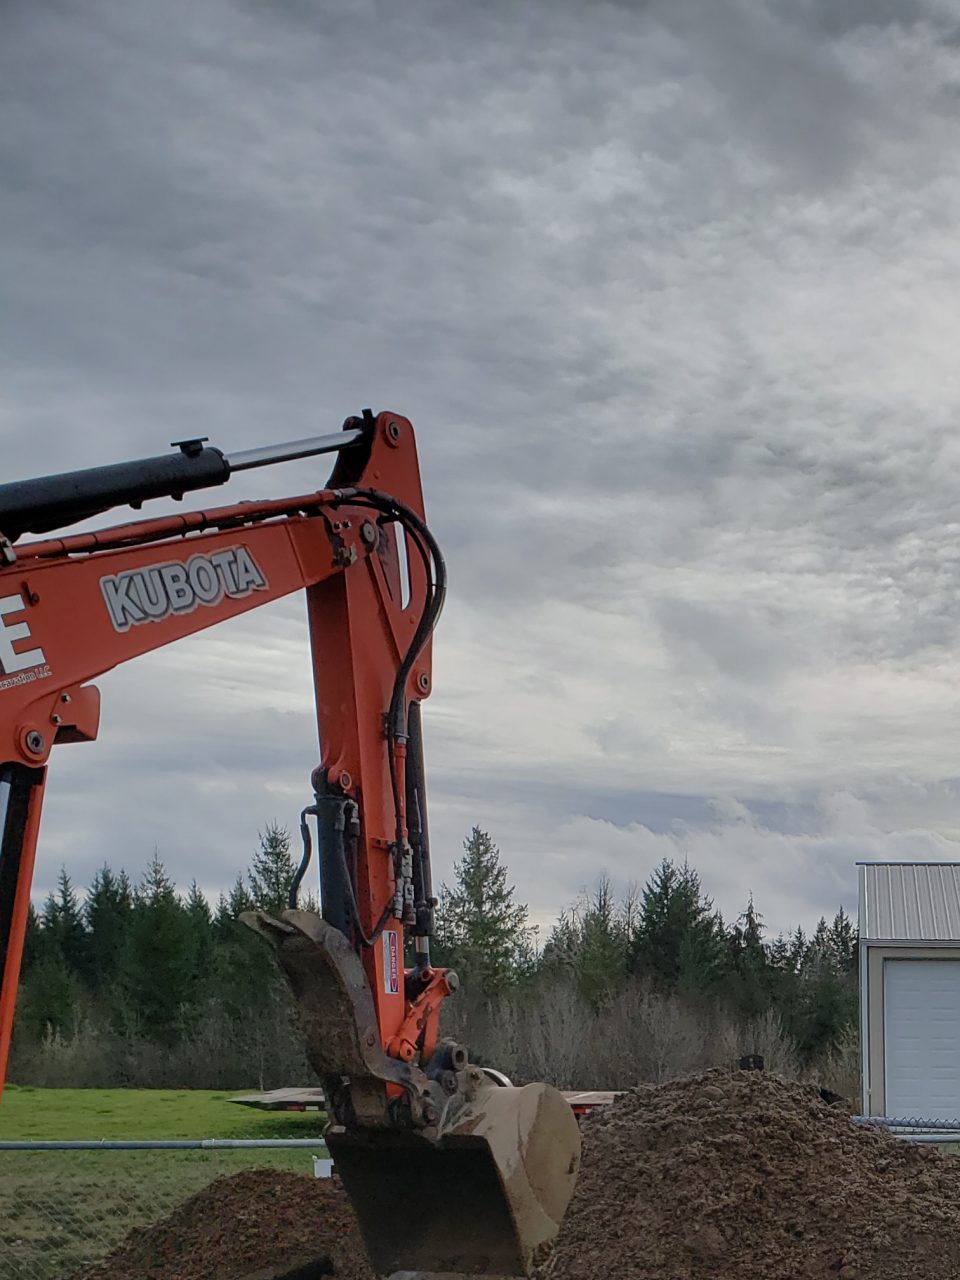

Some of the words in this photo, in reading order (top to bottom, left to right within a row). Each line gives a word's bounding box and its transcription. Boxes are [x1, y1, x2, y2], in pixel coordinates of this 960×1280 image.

[102, 547, 267, 628] KUBOTA
[0, 593, 46, 675] E
[0, 670, 36, 691] cavation
